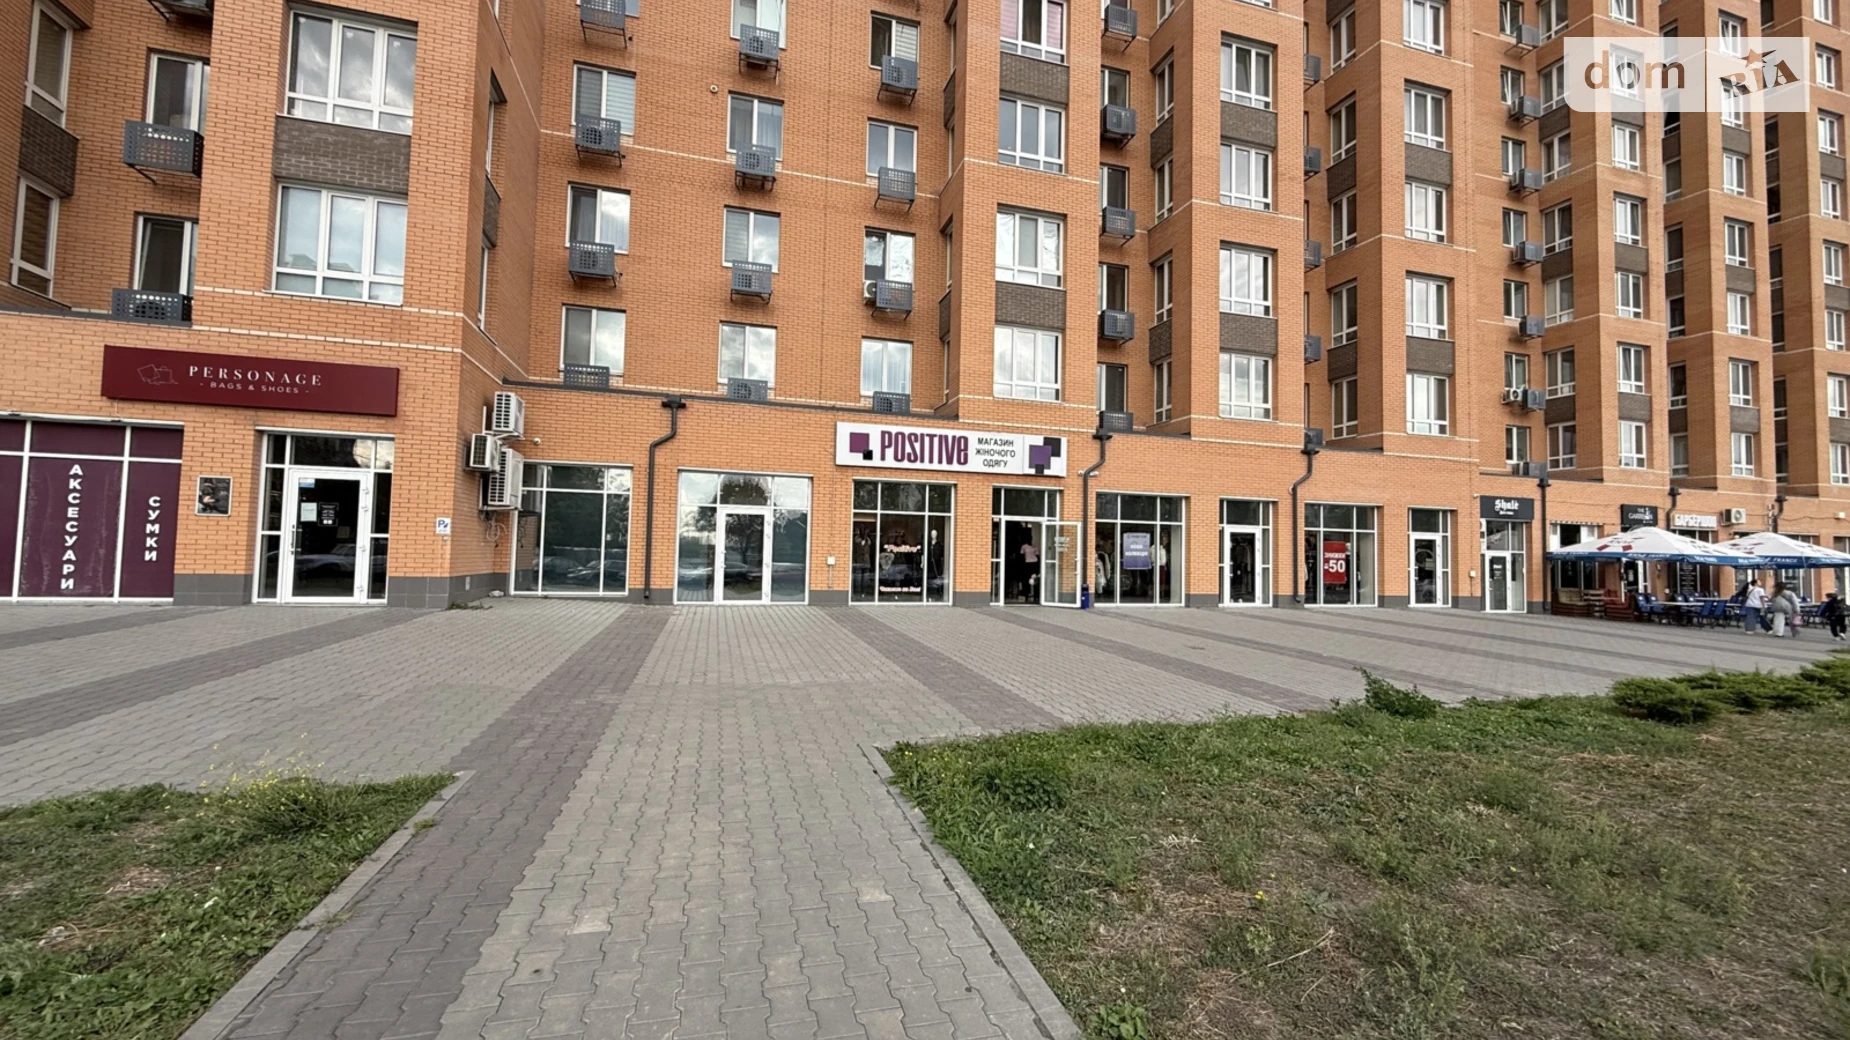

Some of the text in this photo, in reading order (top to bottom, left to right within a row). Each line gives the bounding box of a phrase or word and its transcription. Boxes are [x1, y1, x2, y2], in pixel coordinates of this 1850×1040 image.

[188, 365, 323, 387] PERSONAGE
[210, 381, 243, 391] BAGS
[261, 385, 300, 394] SHOES
[977, 437, 1014, 448] МАГАЗИН
[975, 447, 1016, 459] ЖІНОЧОГО
[982, 458, 1008, 469] ОДЯГУ
[60, 464, 83, 590] АКСЕСУАРИ
[143, 496, 161, 561] СУМКИ
